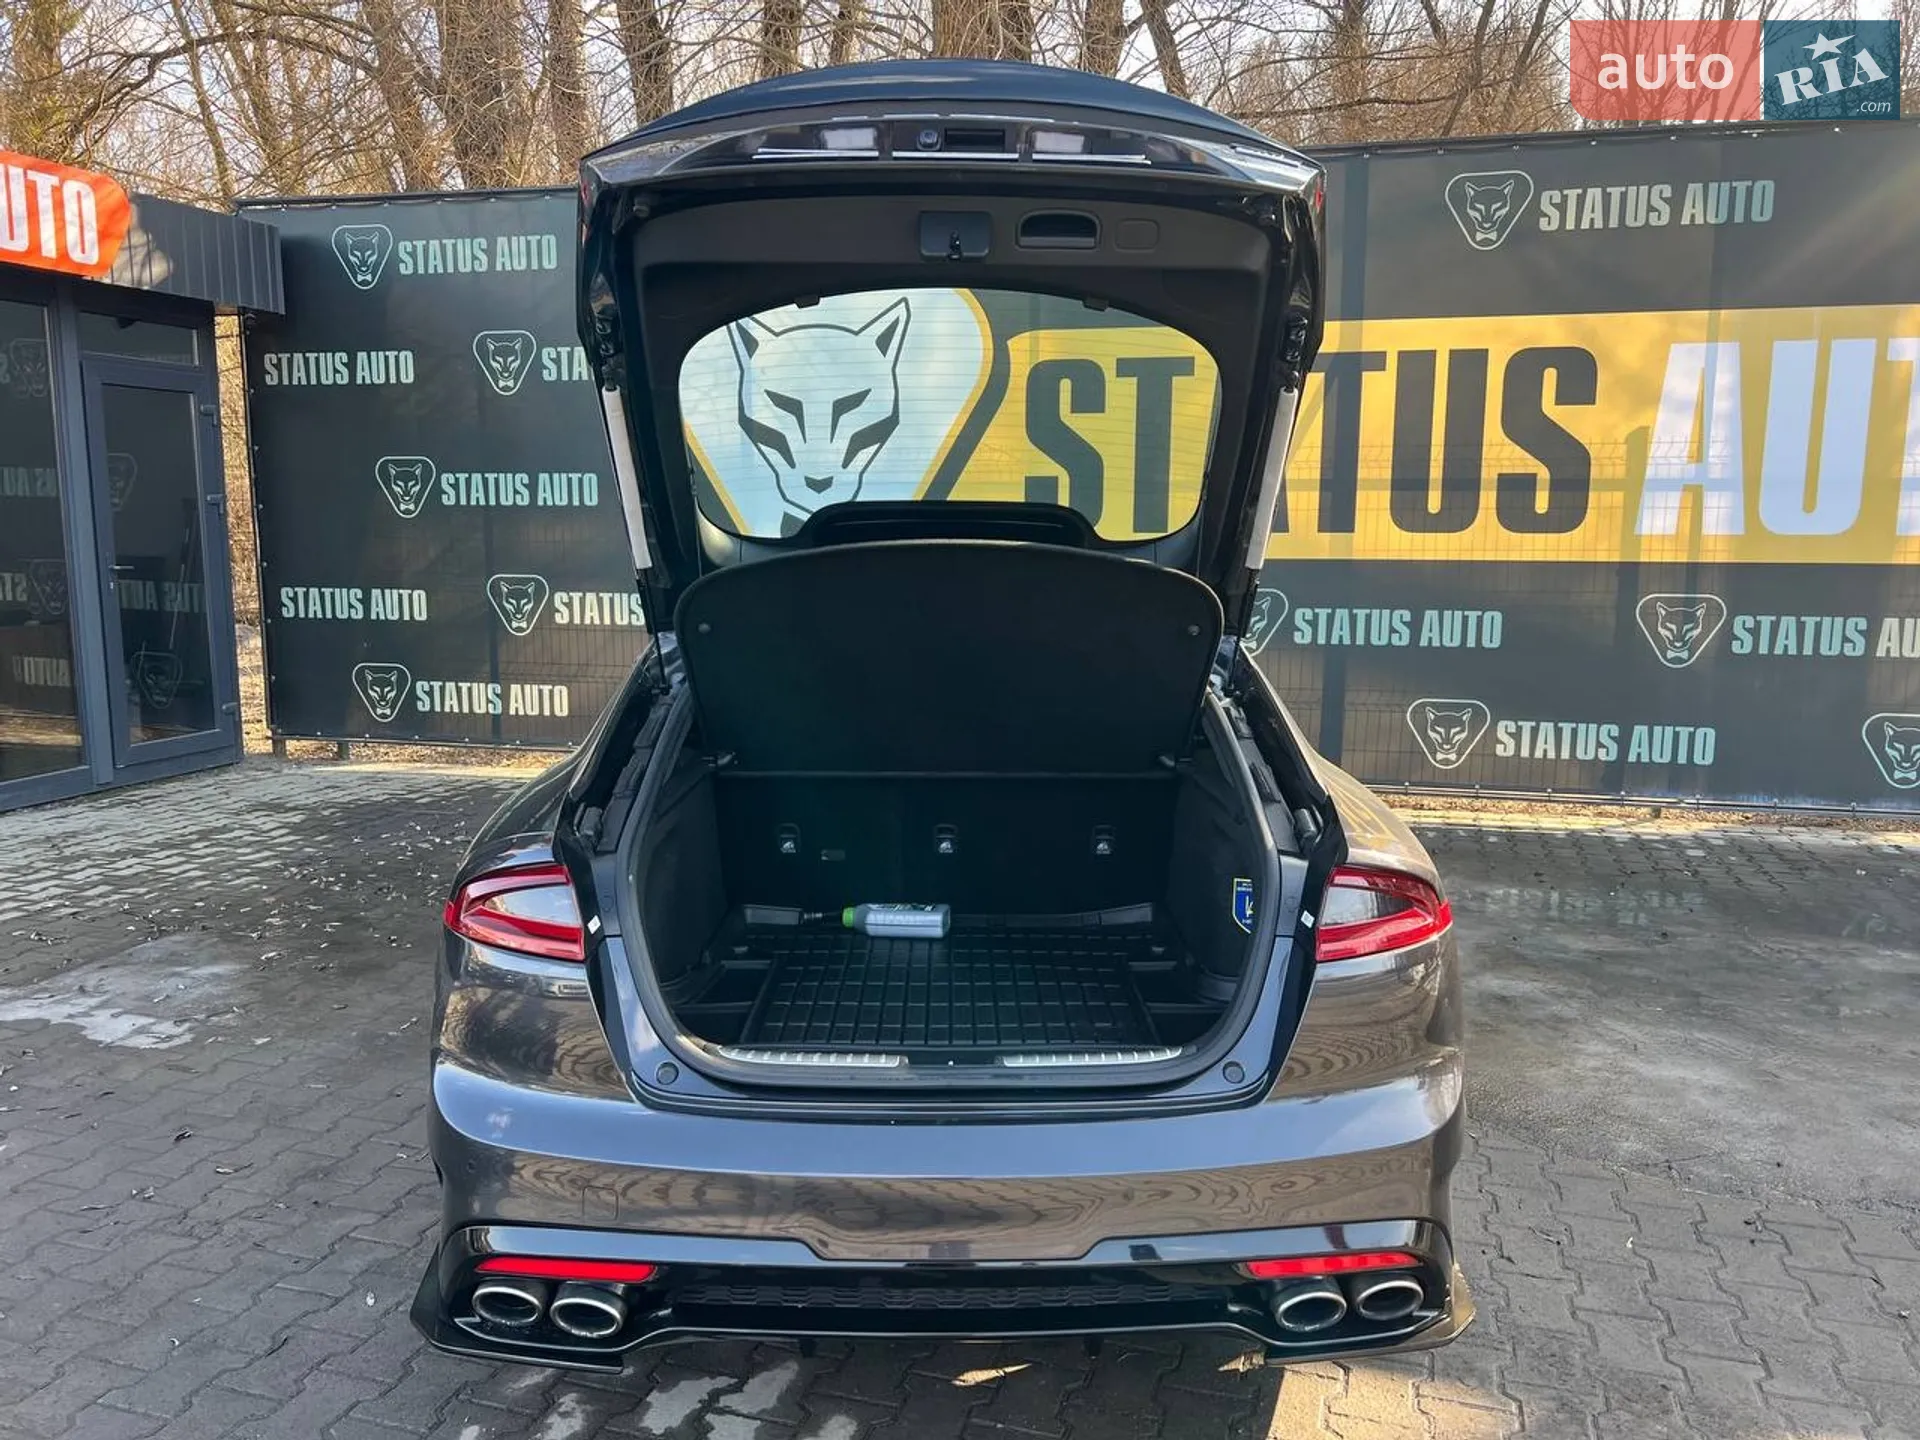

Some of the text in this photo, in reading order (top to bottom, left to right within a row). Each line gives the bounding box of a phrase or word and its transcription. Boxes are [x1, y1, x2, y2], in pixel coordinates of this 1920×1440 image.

[1539, 180, 1775, 231] STATUS AUTO
[398, 234, 558, 275] STATUS AUTO
[264, 350, 415, 386] STATUS AUTO
[440, 471, 599, 507] STATUS AUTO
[280, 586, 428, 621] STATUS AUTO
[554, 591, 646, 626] STATUS
[1293, 607, 1503, 648] STATUS AUTO
[1731, 615, 1868, 657] STATUS
[415, 680, 570, 717] STATUS AUTO
[1495, 720, 1716, 765] STATUS AUTO
